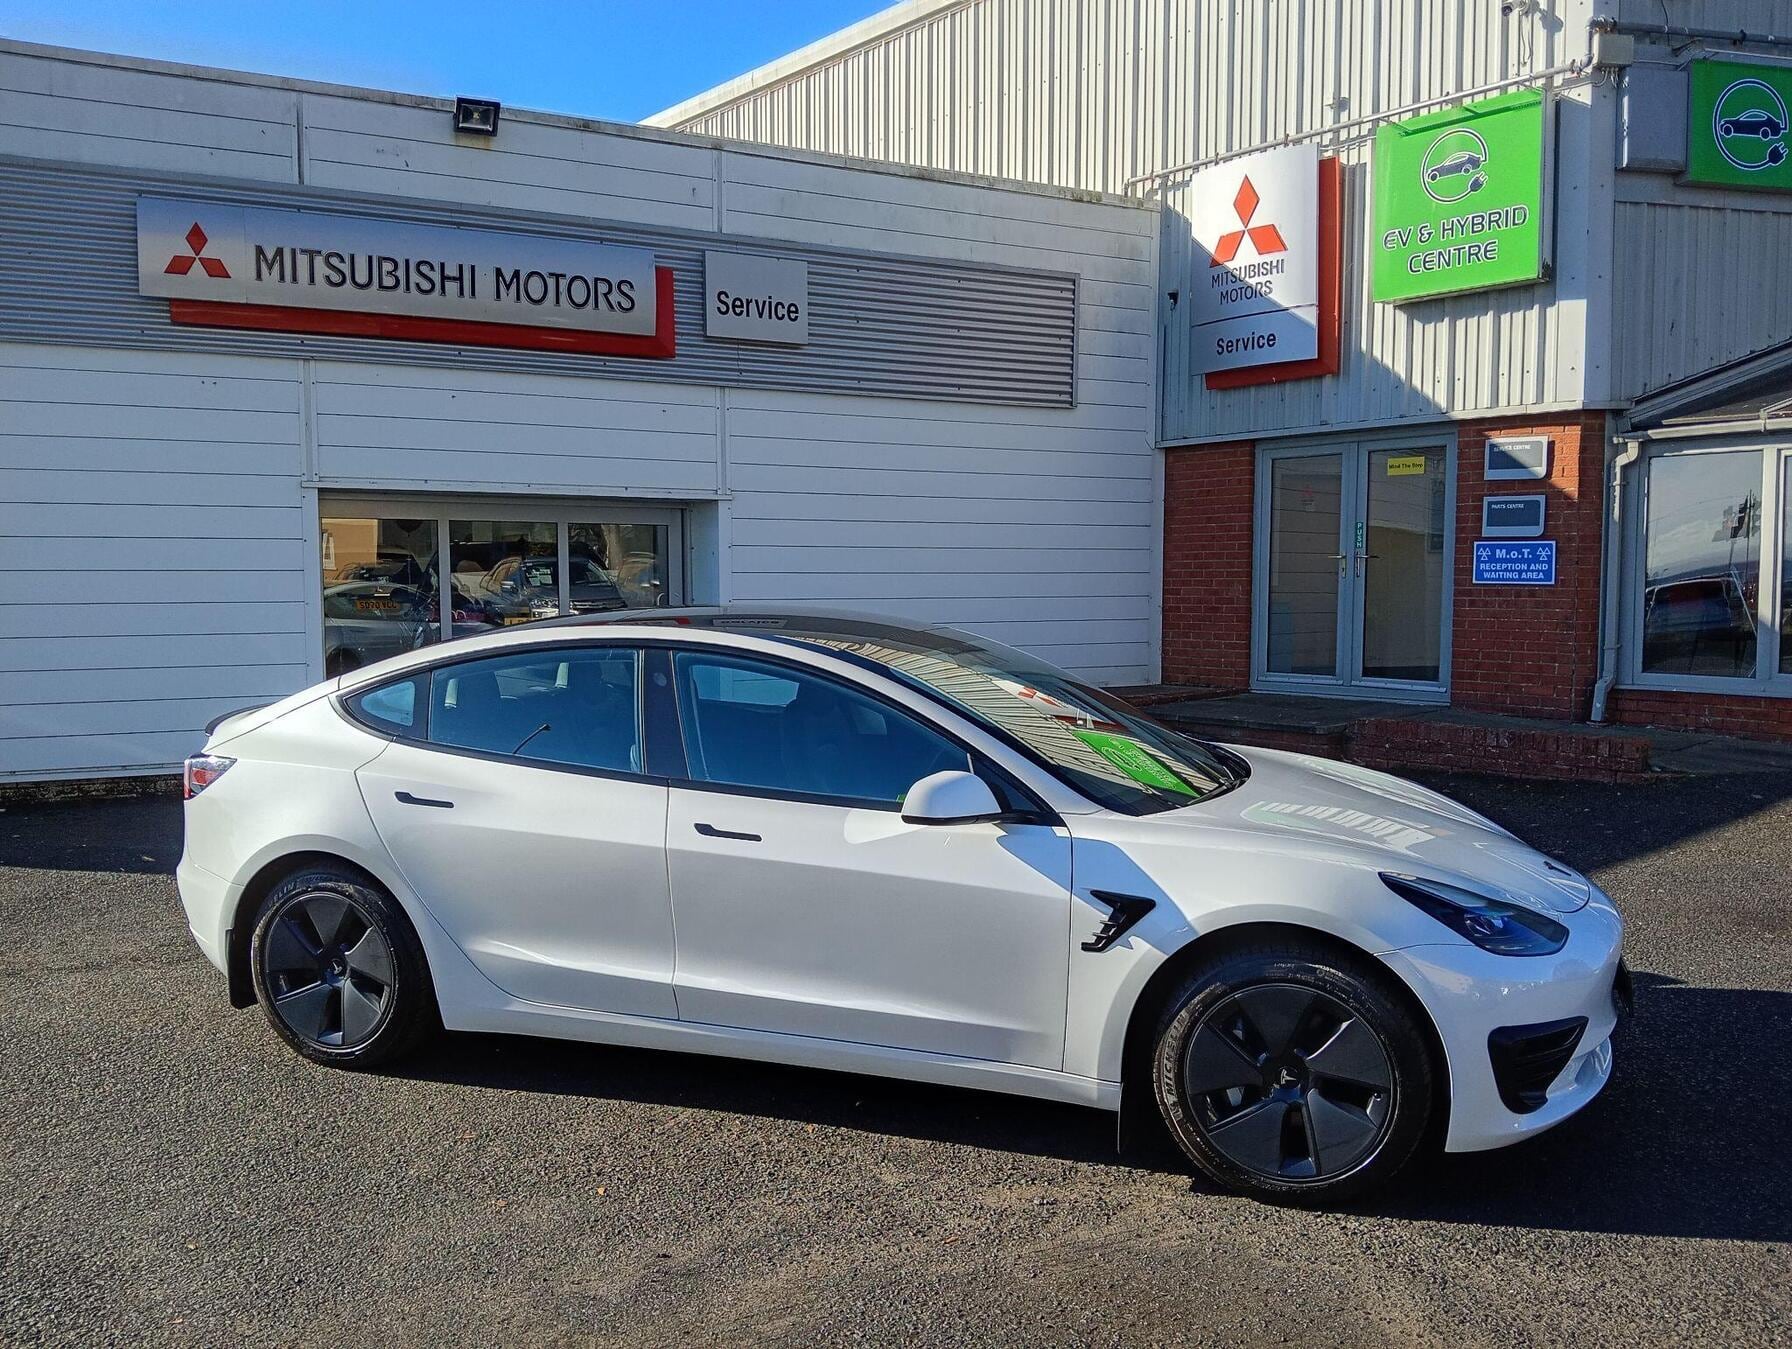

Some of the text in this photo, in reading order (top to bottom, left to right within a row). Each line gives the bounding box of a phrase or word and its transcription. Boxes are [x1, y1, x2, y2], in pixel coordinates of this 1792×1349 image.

[1383, 205, 1528, 250] EV & HYBRID
[1408, 240, 1498, 274] CENTRE
[253, 243, 637, 314] MITSUBISHI MOTORS
[1211, 258, 1285, 289] MITSUBISHI
[716, 290, 801, 323] Service
[1219, 280, 1273, 306] MOTORS
[1216, 331, 1277, 356] Service
[1495, 548, 1533, 559] M.o.T.
[1483, 571, 1544, 579] WAITING AREA
